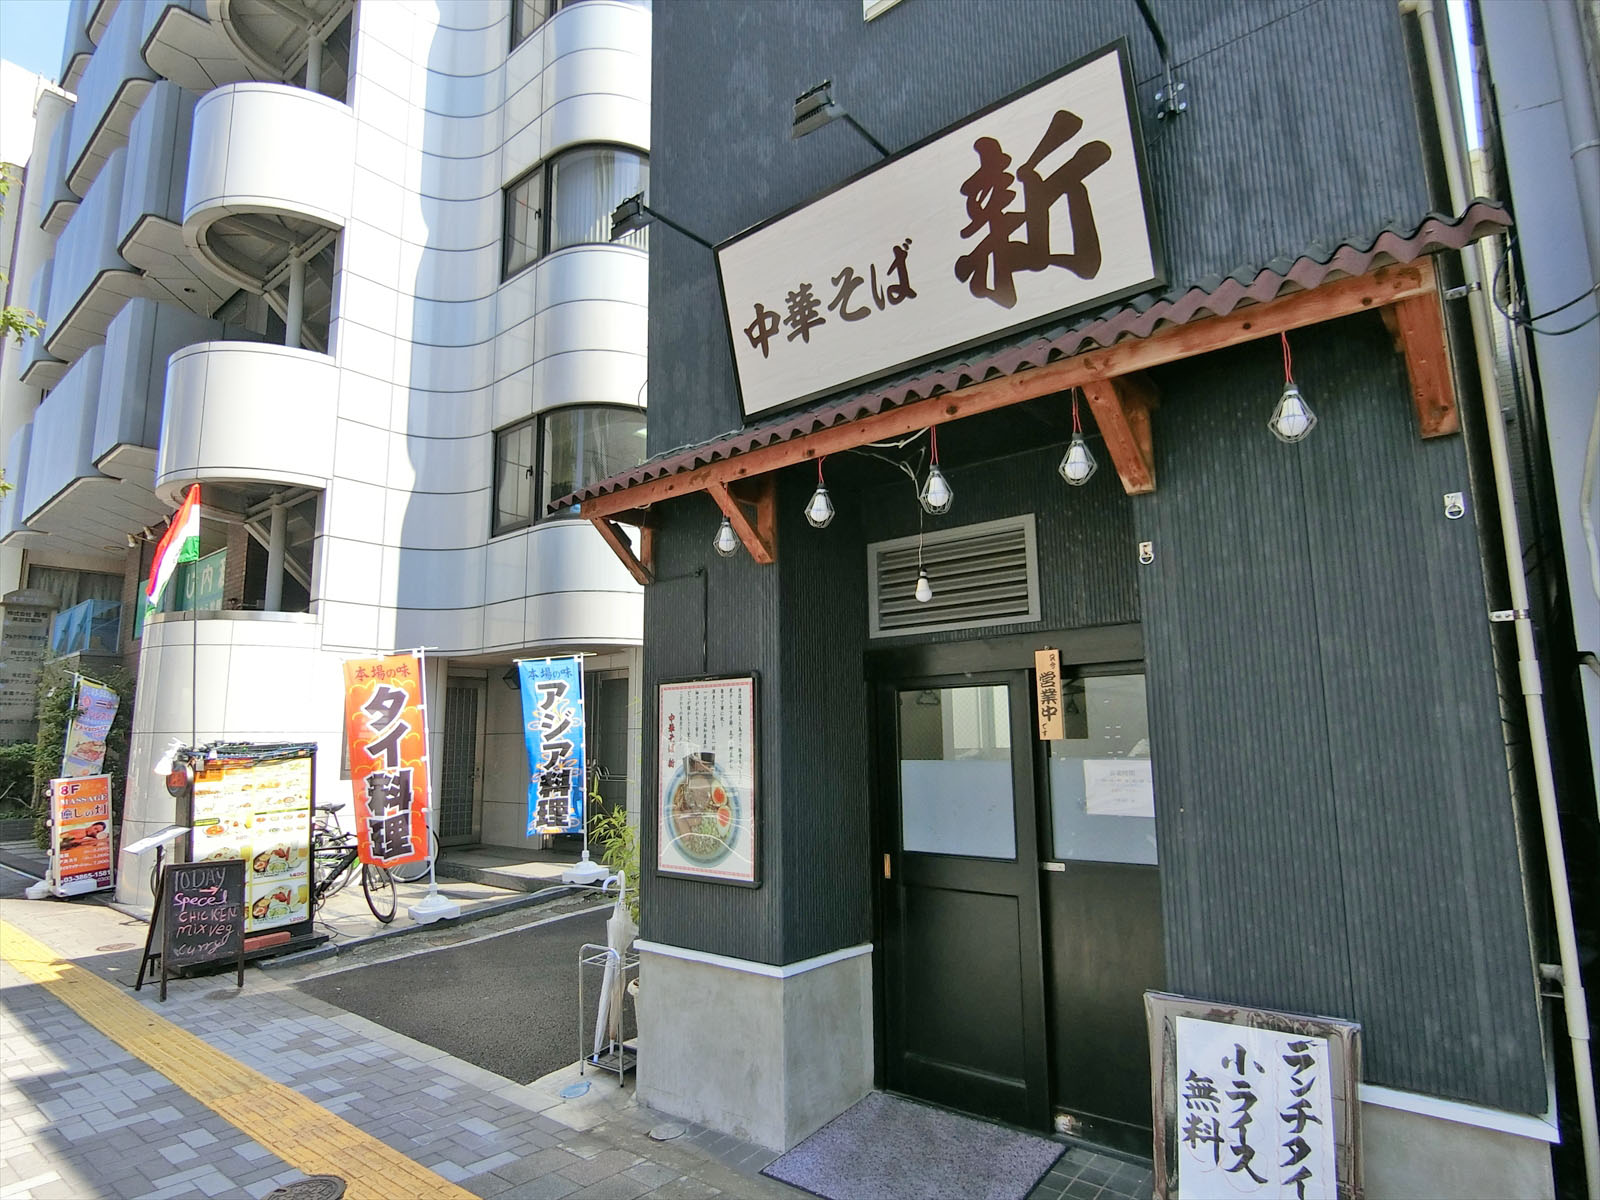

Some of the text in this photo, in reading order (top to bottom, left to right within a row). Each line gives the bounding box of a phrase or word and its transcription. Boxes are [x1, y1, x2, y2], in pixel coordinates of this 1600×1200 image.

[743, 109, 1113, 360] 中華そば 新
[354, 663, 412, 682] 本場の味
[527, 666, 574, 682] 本場の味
[1039, 671, 1059, 722] 営業中
[534, 680, 574, 829] アジア料理
[667, 712, 676, 753] 中華そば
[60, 784, 80, 796] 8F
[362, 685, 414, 861] タイ料理
[61, 794, 107, 805] MASSAGE
[174, 867, 226, 892] TODAY
[178, 907, 237, 923] CHICKEN
[1182, 1068, 1225, 1166] 無料
[1221, 1043, 1269, 1184] 小ライス
[1280, 1040, 1323, 1200] ランチタイ
